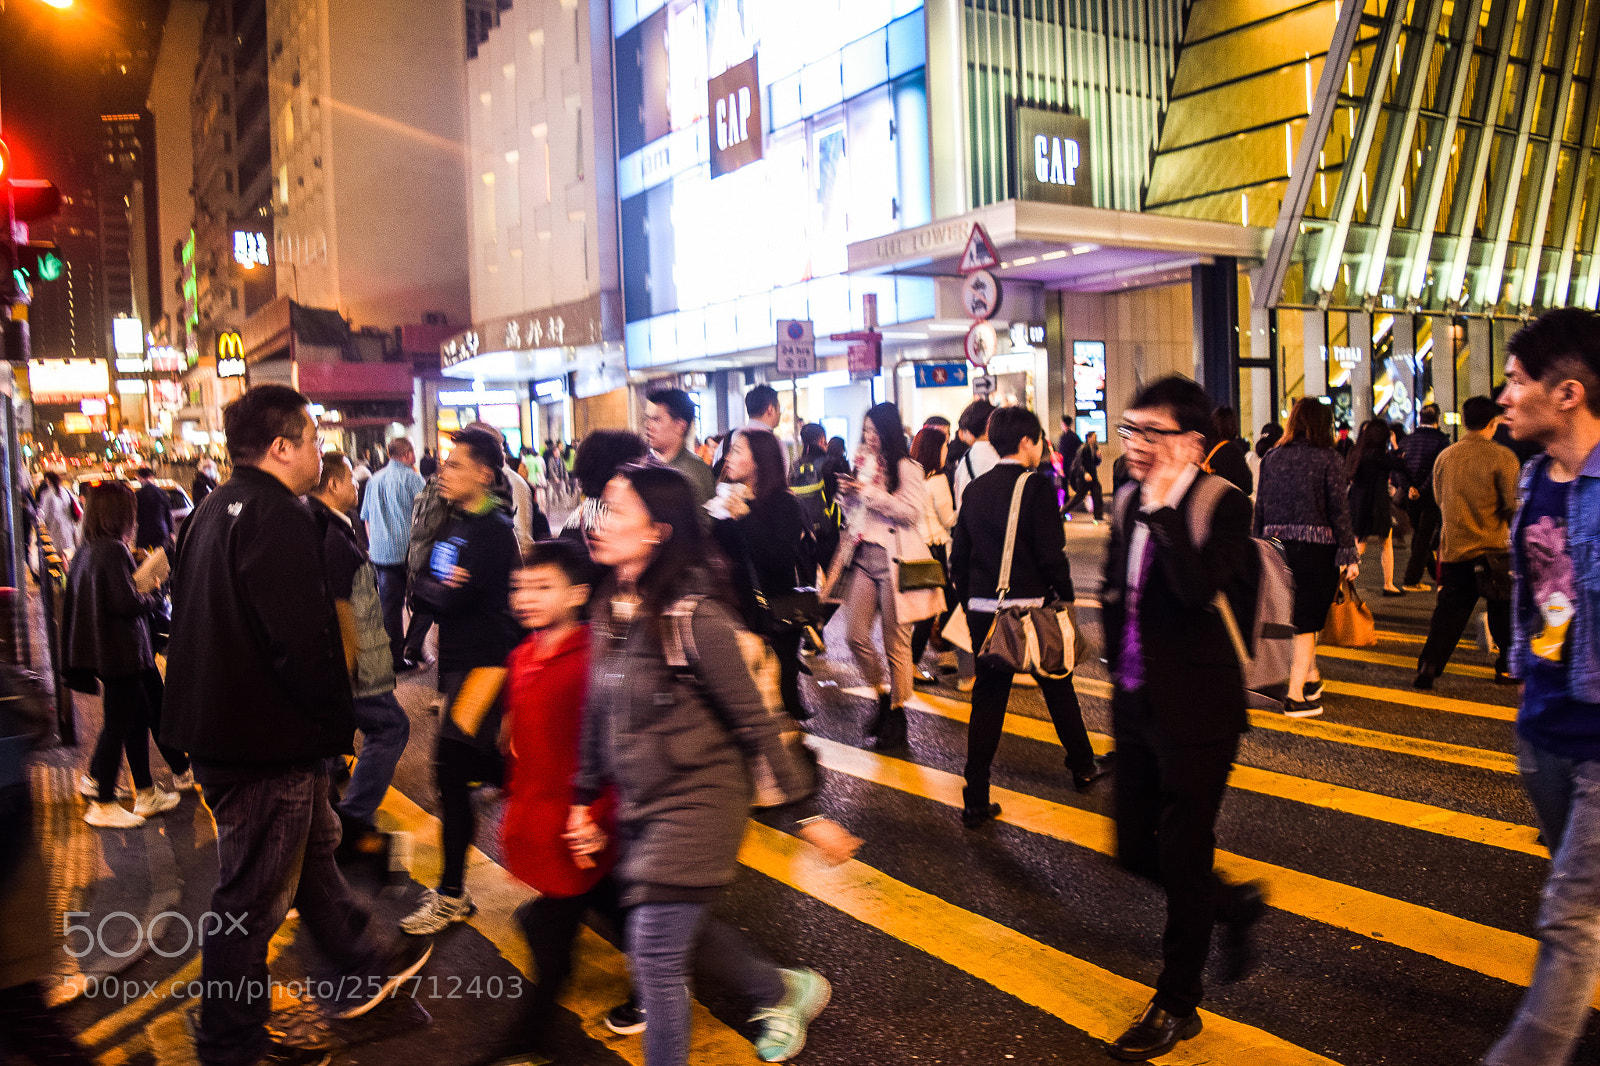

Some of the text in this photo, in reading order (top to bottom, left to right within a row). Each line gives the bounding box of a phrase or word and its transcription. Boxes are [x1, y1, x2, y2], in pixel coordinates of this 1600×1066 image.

[715, 86, 752, 151] GAP
[1034, 134, 1081, 186] GAP
[911, 221, 970, 251] TOWER
